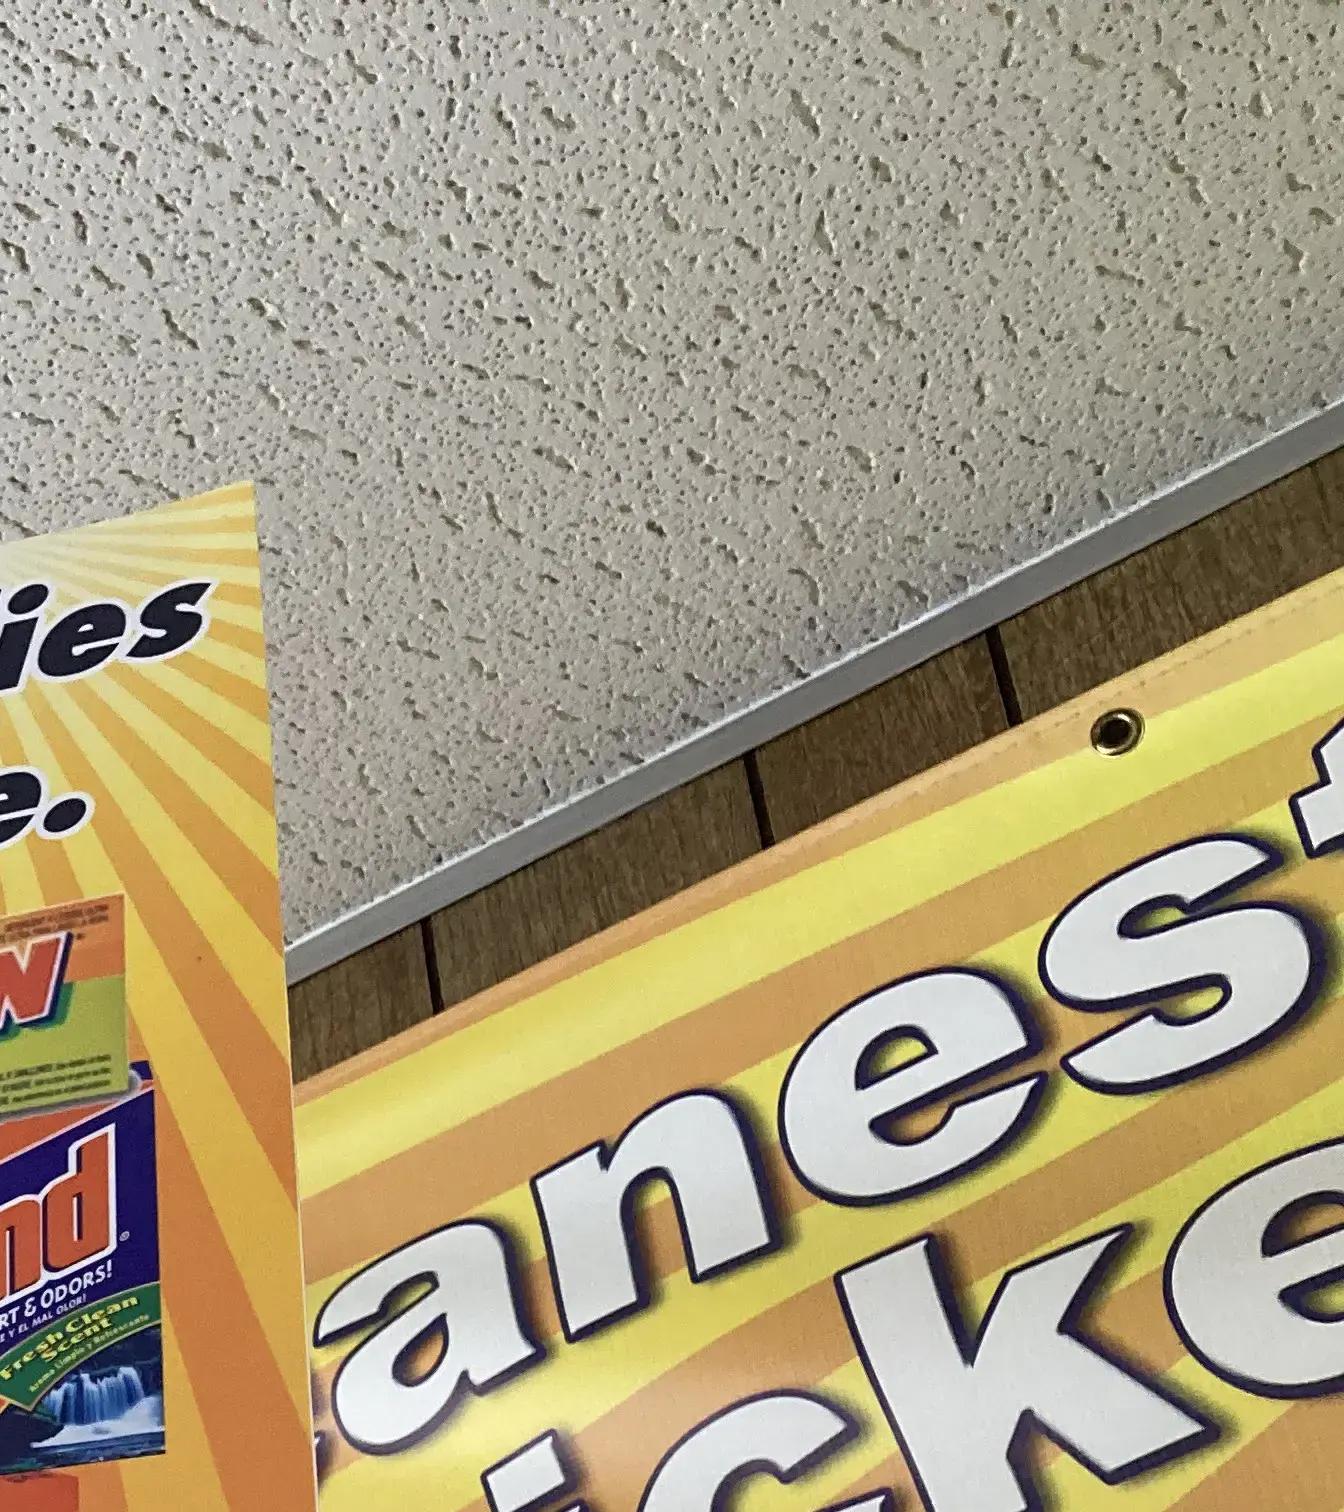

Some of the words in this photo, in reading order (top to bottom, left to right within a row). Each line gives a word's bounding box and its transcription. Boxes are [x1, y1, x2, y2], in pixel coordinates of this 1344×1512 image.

[24, 1296, 38, 1317] &
[40, 1259, 113, 1308] ODORS!
[8, 1329, 15, 1339] Y
[18, 1322, 29, 1334] EL
[32, 1312, 53, 1328] MAL
[65, 1296, 139, 1333] Clean
[40, 1319, 113, 1362] Scent
